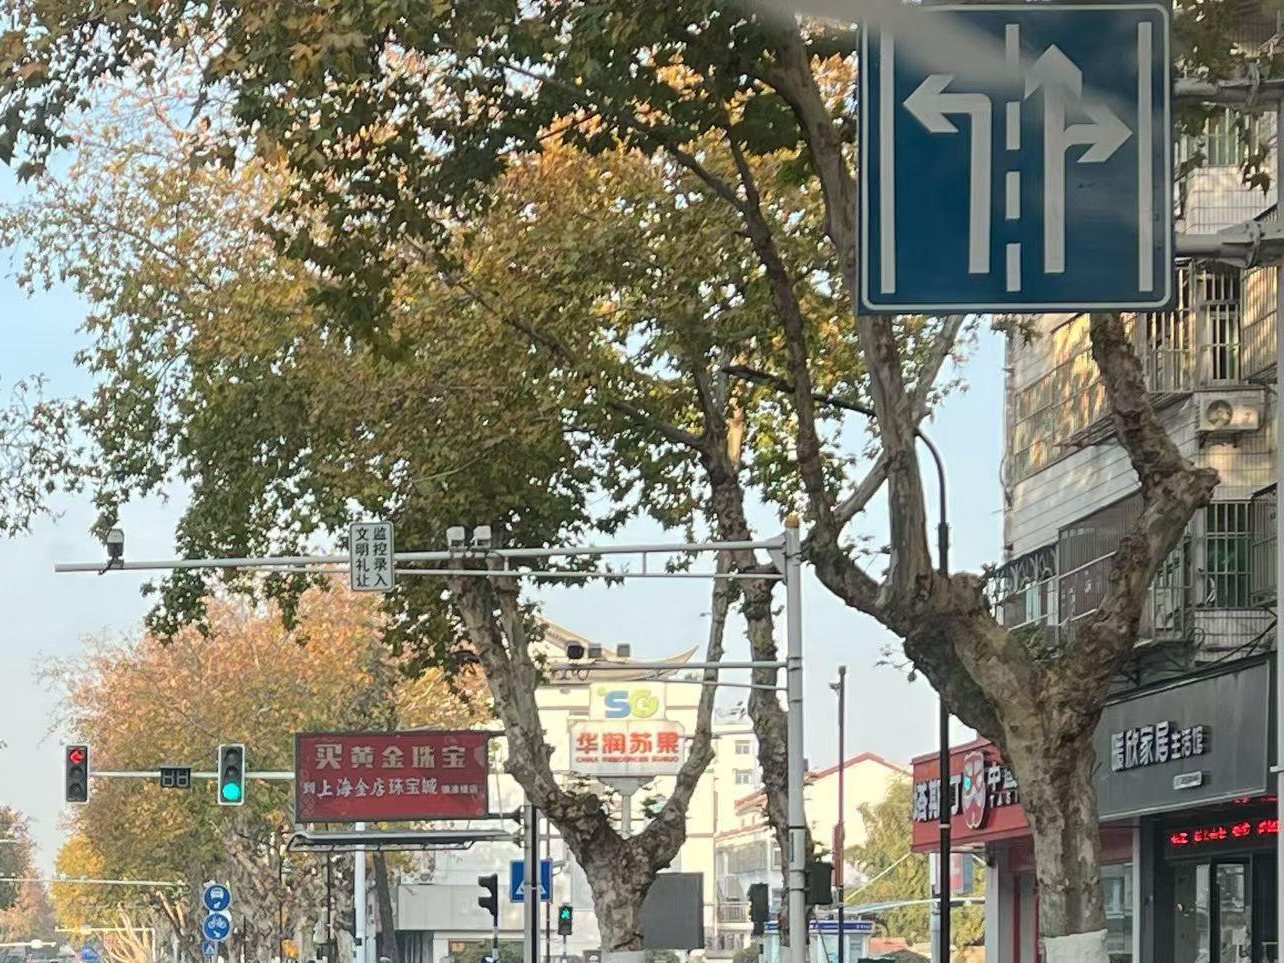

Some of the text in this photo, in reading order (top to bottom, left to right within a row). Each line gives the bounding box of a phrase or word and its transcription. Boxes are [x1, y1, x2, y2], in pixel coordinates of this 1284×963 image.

[355, 526, 371, 588] 文明礼让
[373, 526, 389, 588] 监控录入
[315, 743, 466, 770] 买黄金珠宝
[576, 732, 679, 754] 华润苏果
